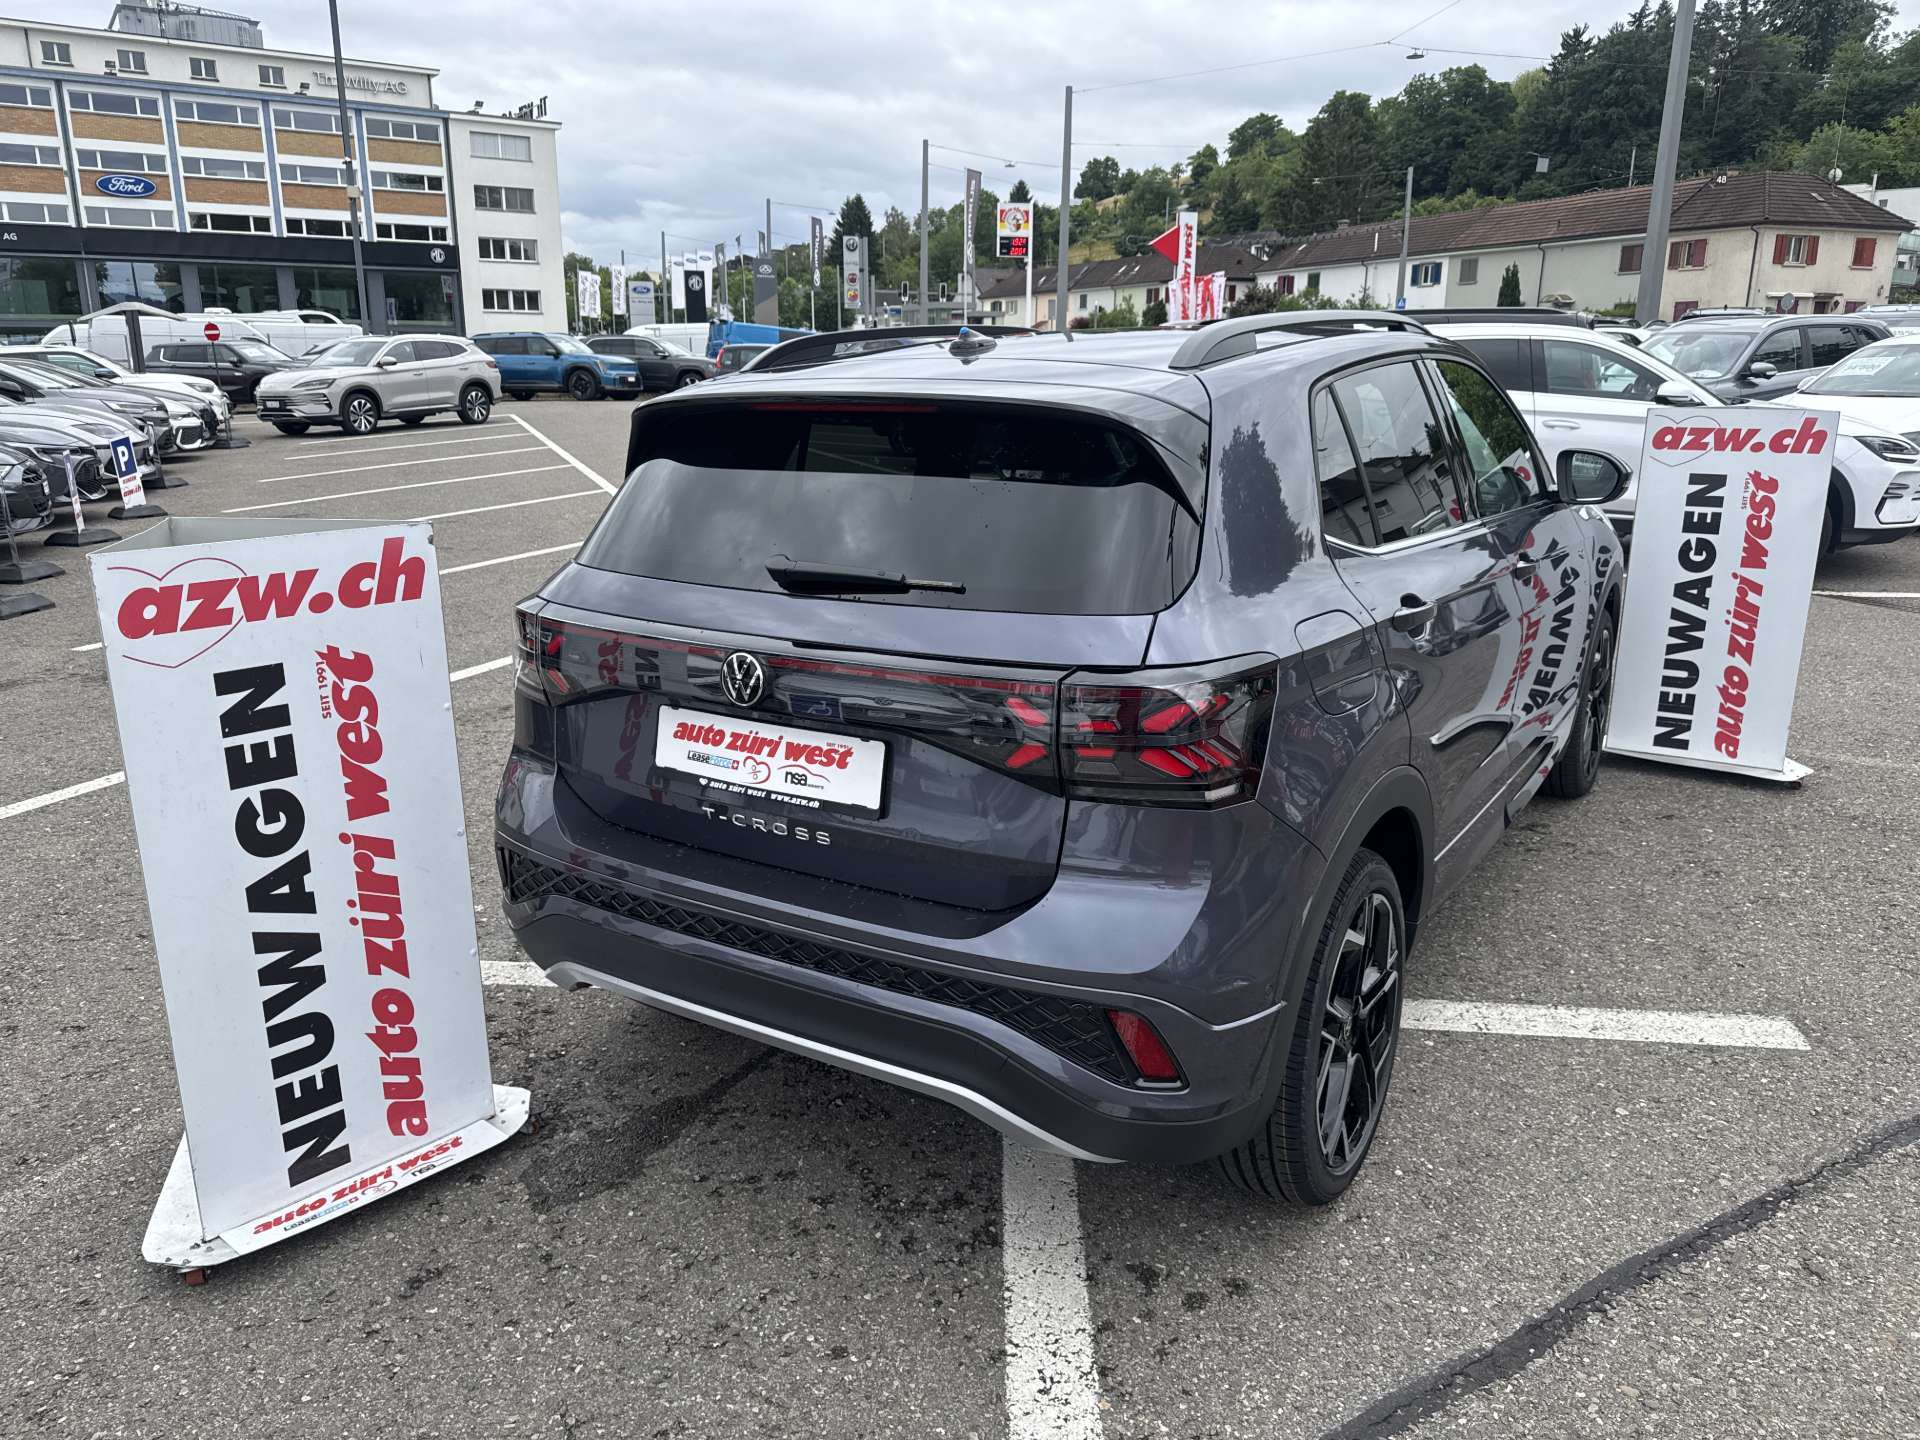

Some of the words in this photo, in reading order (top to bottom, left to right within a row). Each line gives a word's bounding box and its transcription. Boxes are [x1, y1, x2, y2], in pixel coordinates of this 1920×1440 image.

[384, 79, 408, 96] AG
[3, 232, 18, 241] AG
[1184, 223, 1193, 259] west
[1652, 417, 1828, 455] azw.ch
[116, 445, 129, 472] P
[1740, 470, 1779, 570] west
[1741, 496, 1749, 510] SEIT
[117, 536, 426, 640] azw.ch
[1652, 473, 1728, 751] NEUWAGEN
[1724, 572, 1764, 666] züri
[315, 660, 329, 690] 1991
[320, 694, 332, 719] SEIT
[1714, 665, 1749, 759] auto
[315, 644, 390, 822] west
[673, 721, 726, 747] auto
[725, 730, 783, 759] züri
[782, 741, 855, 770] west
[709, 781, 727, 791] auto
[747, 788, 767, 798] west
[784, 770, 808, 787] nsa
[701, 806, 831, 846] T-CROSS
[213, 662, 351, 1188] NEUWAGEN
[338, 832, 410, 979] züri
[364, 987, 430, 1136] auto
[253, 1197, 328, 1235] auto
[332, 1165, 393, 1202] züri
[397, 1136, 463, 1172] west
